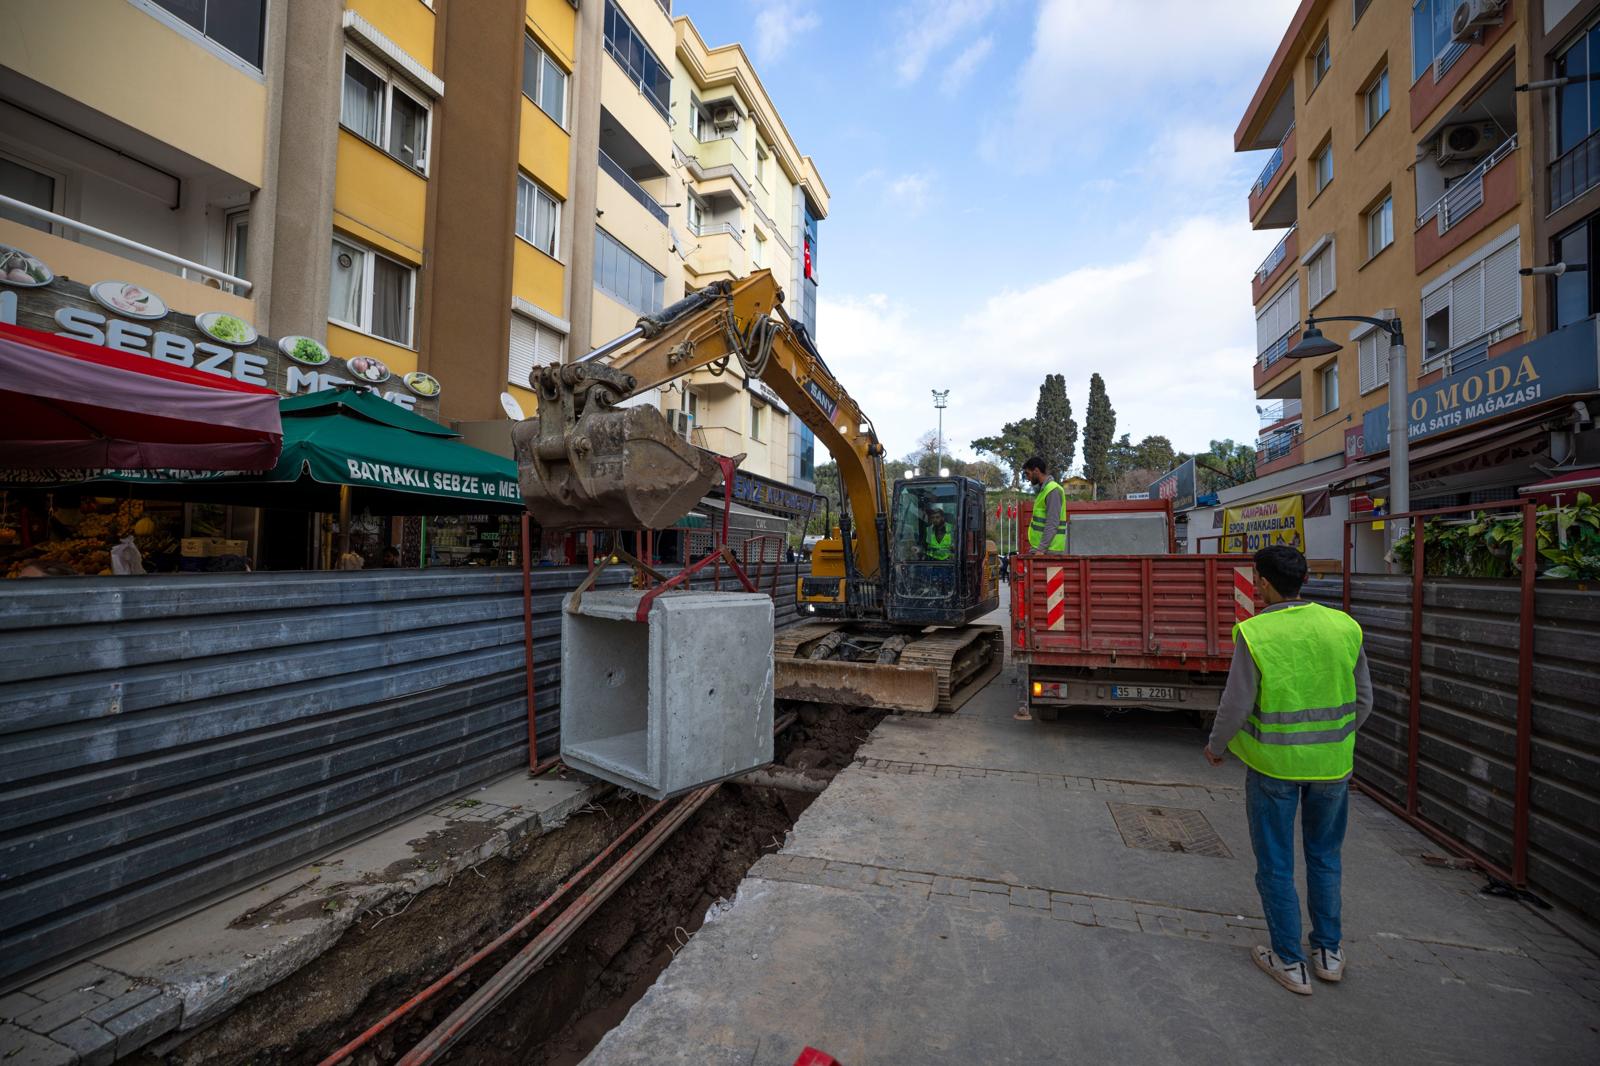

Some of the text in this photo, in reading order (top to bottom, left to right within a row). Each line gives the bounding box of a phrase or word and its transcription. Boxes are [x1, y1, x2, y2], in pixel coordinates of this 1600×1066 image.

[54, 307, 269, 388] SEBZE
[810, 382, 833, 413] SANY
[1435, 355, 1541, 414] MODA
[1429, 410, 1462, 431] SATIŞ
[1465, 384, 1541, 420] MAĞAZASI
[347, 458, 431, 488] BAYRAKLI
[432, 471, 480, 495] SEBZE
[482, 482, 496, 496] ve
[1240, 503, 1279, 520] KAMPANYA
[1246, 516, 1296, 532] AYAKKABILAR
[1117, 687, 1173, 698] 35 R 2201
